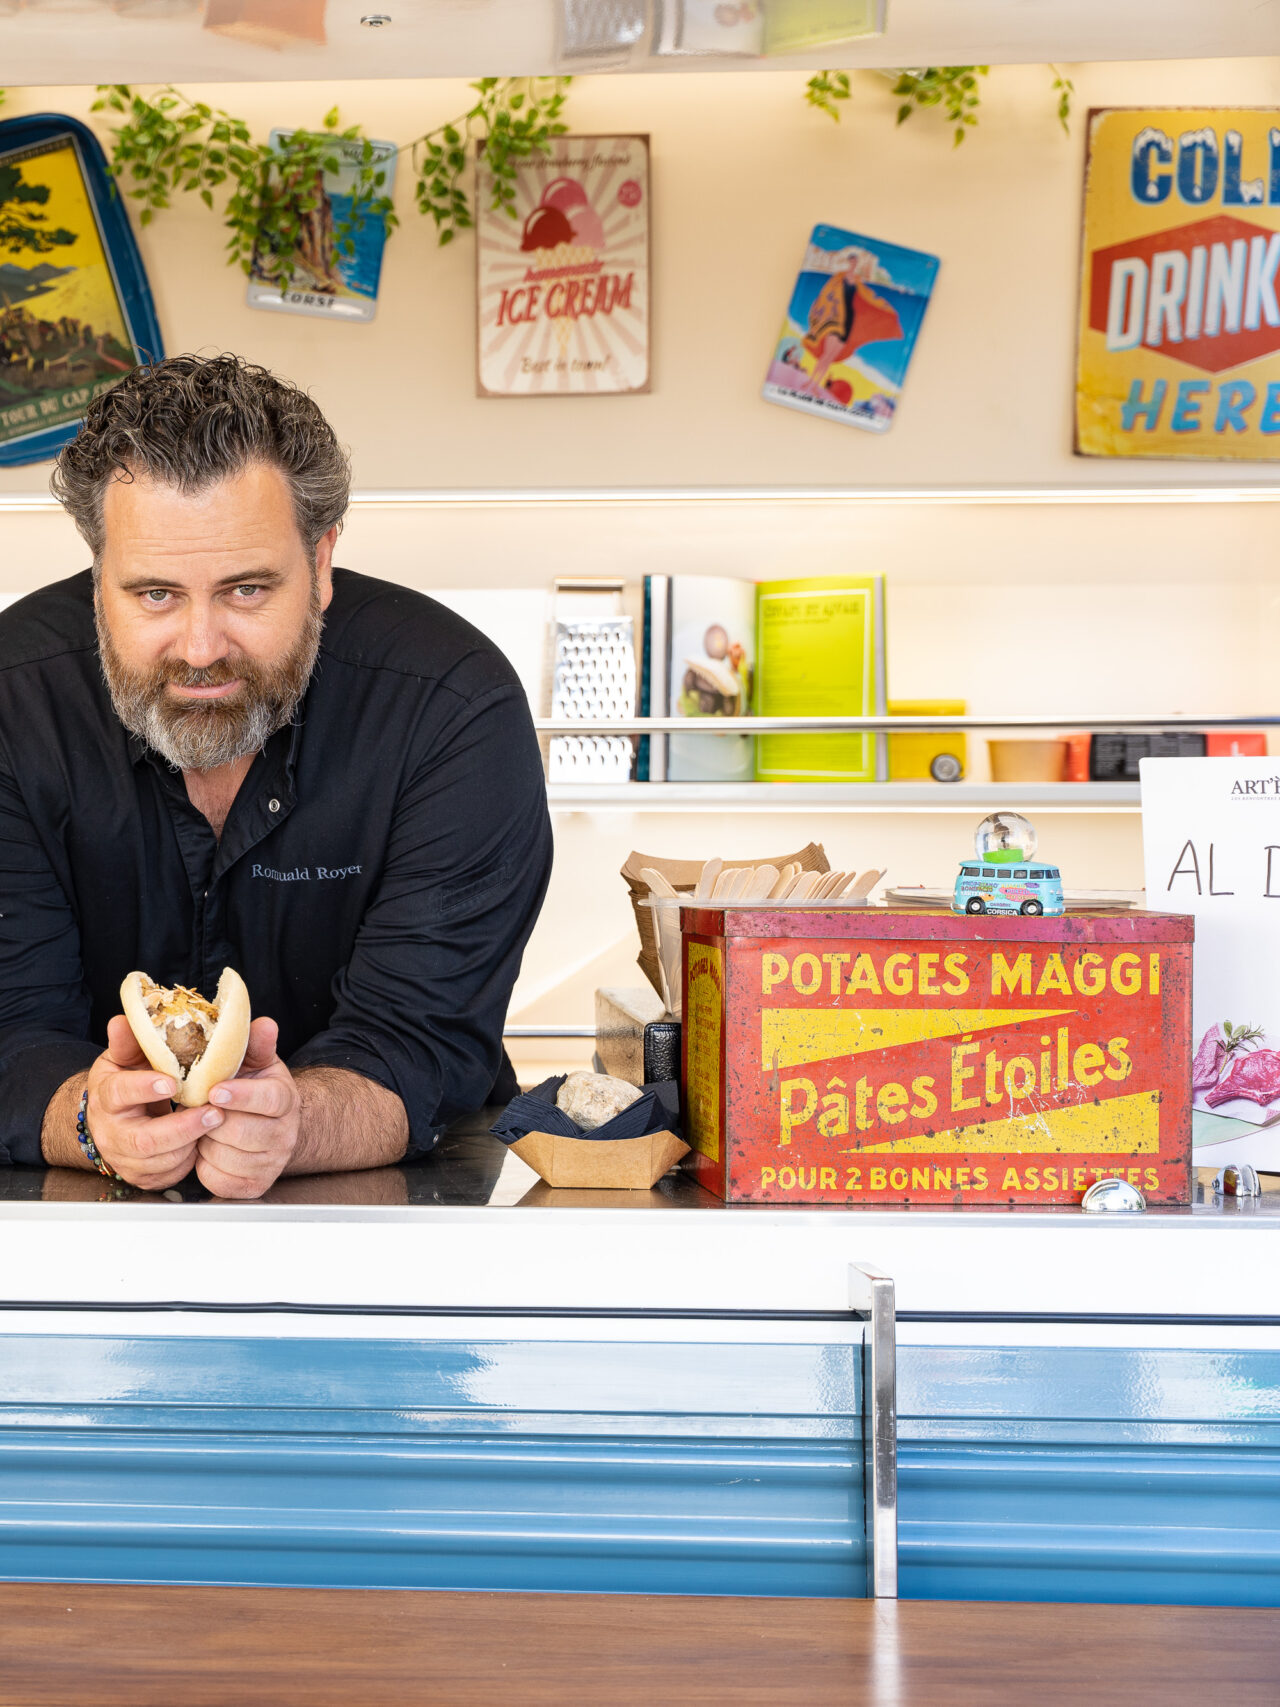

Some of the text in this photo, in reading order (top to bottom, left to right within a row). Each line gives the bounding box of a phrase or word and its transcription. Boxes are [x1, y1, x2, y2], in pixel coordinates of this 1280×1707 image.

[1131, 127, 1280, 207] COL
[495, 271, 634, 327] ICE CREAM
[251, 863, 362, 882] Romuald Royer
[1167, 840, 1234, 896] AL
[986, 908, 1018, 916] CORSICA
[762, 953, 1160, 996] POTAGES MAGGI
[779, 1075, 936, 1146] Pâtes
[951, 1027, 1132, 1112] Étoiles
[761, 1167, 1160, 1191] POUR 2 BONNES ASSIETTES
